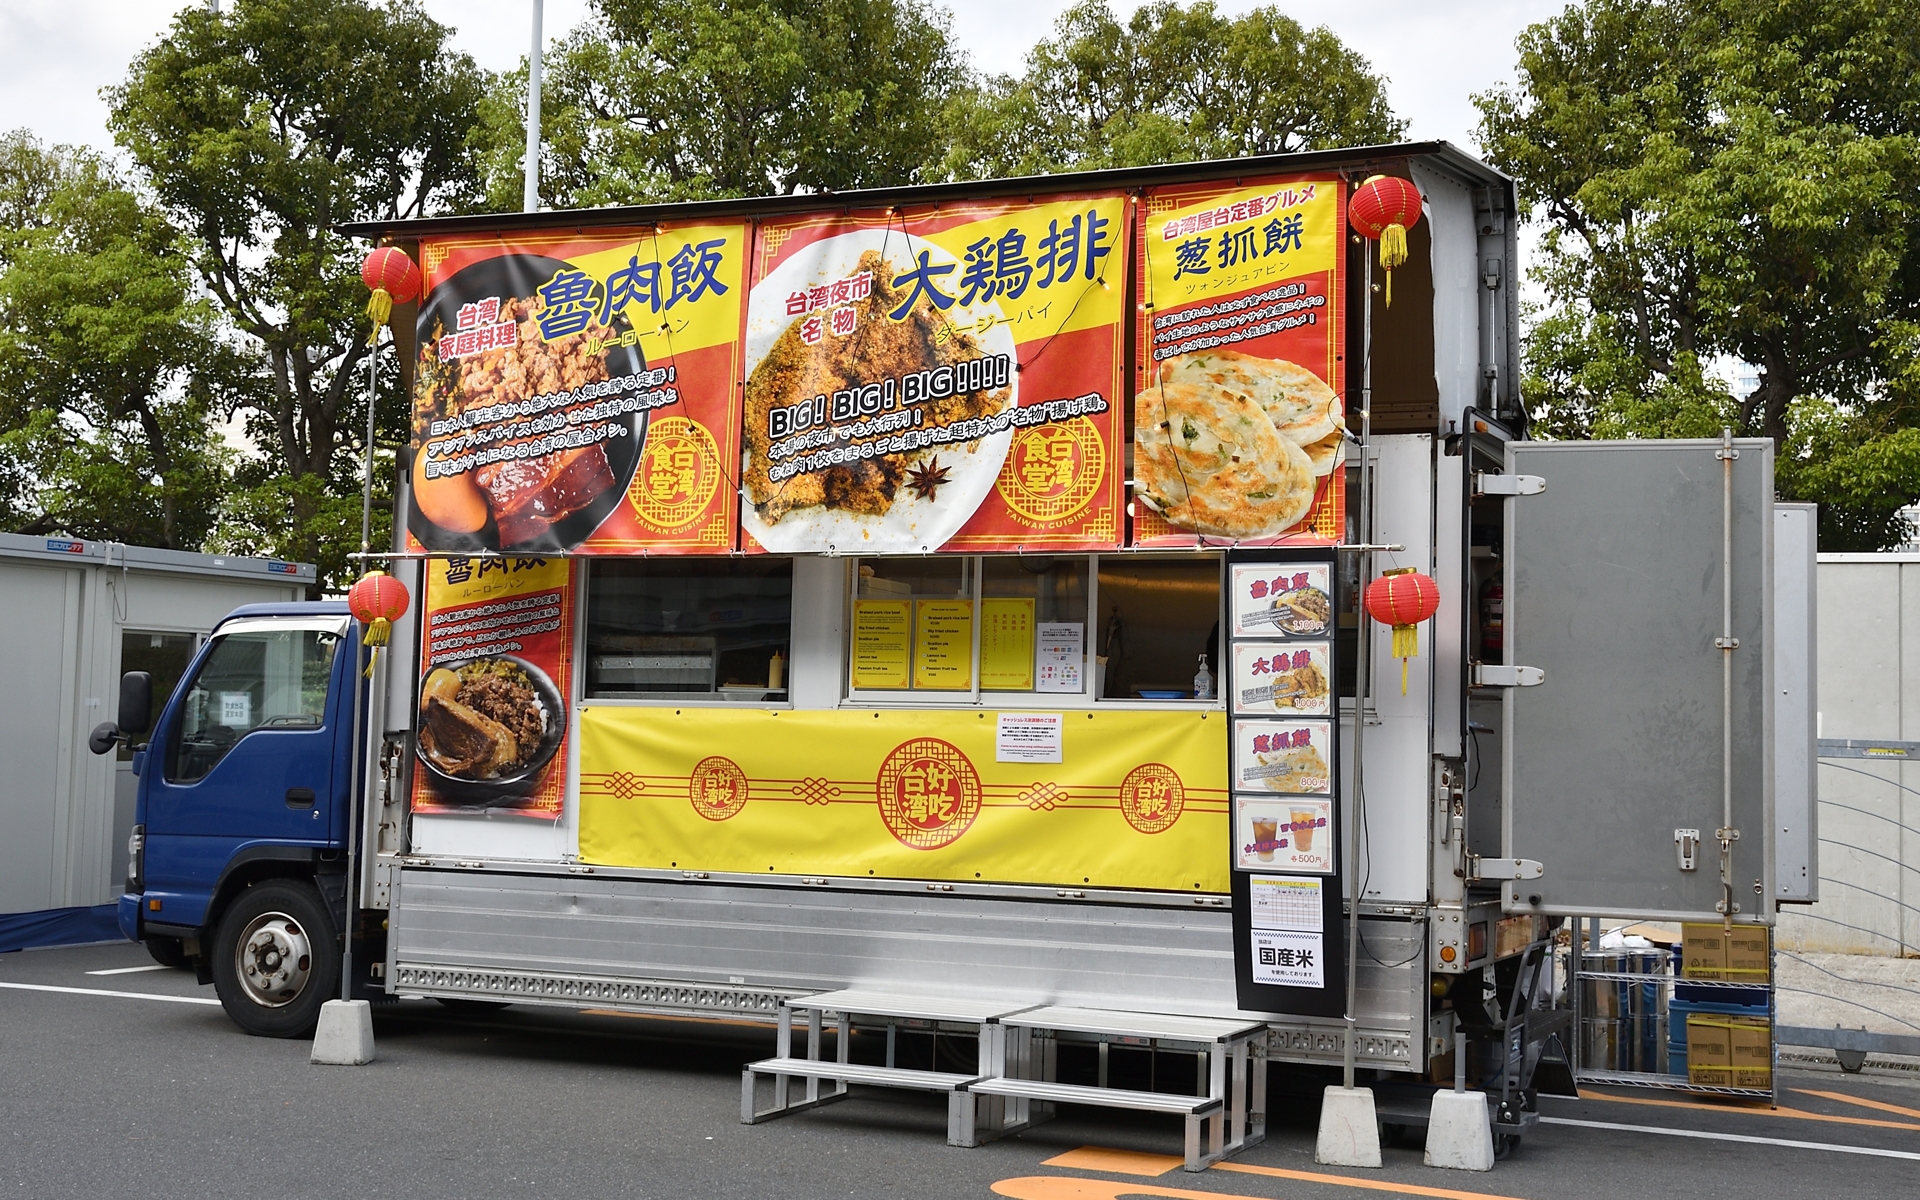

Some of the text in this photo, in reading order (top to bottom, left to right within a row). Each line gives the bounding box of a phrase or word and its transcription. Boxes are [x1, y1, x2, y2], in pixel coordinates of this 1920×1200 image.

[1163, 184, 1316, 240] 台湾屋台定番グルメ
[889, 209, 1110, 321] 大鶏排
[536, 238, 729, 341] 魯肉飯
[785, 273, 871, 316] 台湾夜市
[458, 299, 498, 329] 台湾
[802, 309, 855, 343] 名物
[937, 301, 1052, 344] ダージーパイ
[440, 322, 515, 360] 家庭料理
[428, 388, 677, 457] アジアンスパイスを効かせた独特の風味と
[430, 367, 675, 436] 日本人観光客から絶大な人気を誇る定番！
[770, 396, 823, 438] BIG!
[832, 379, 894, 420] BIG!
[426, 424, 629, 478] 旨味がクセになる台湾の屋台メシ。
[769, 408, 922, 460] 本場の夜市でも大行列！
[634, 513, 707, 535] TAIWAN CUISINE
[1005, 506, 1092, 530] TAIWAN CUISINE
[462, 579, 525, 598] ルーローハン
[1250, 571, 1311, 600] 魯肉飯
[1252, 650, 1311, 676] 大鶏排
[1259, 947, 1314, 968] 国産米
